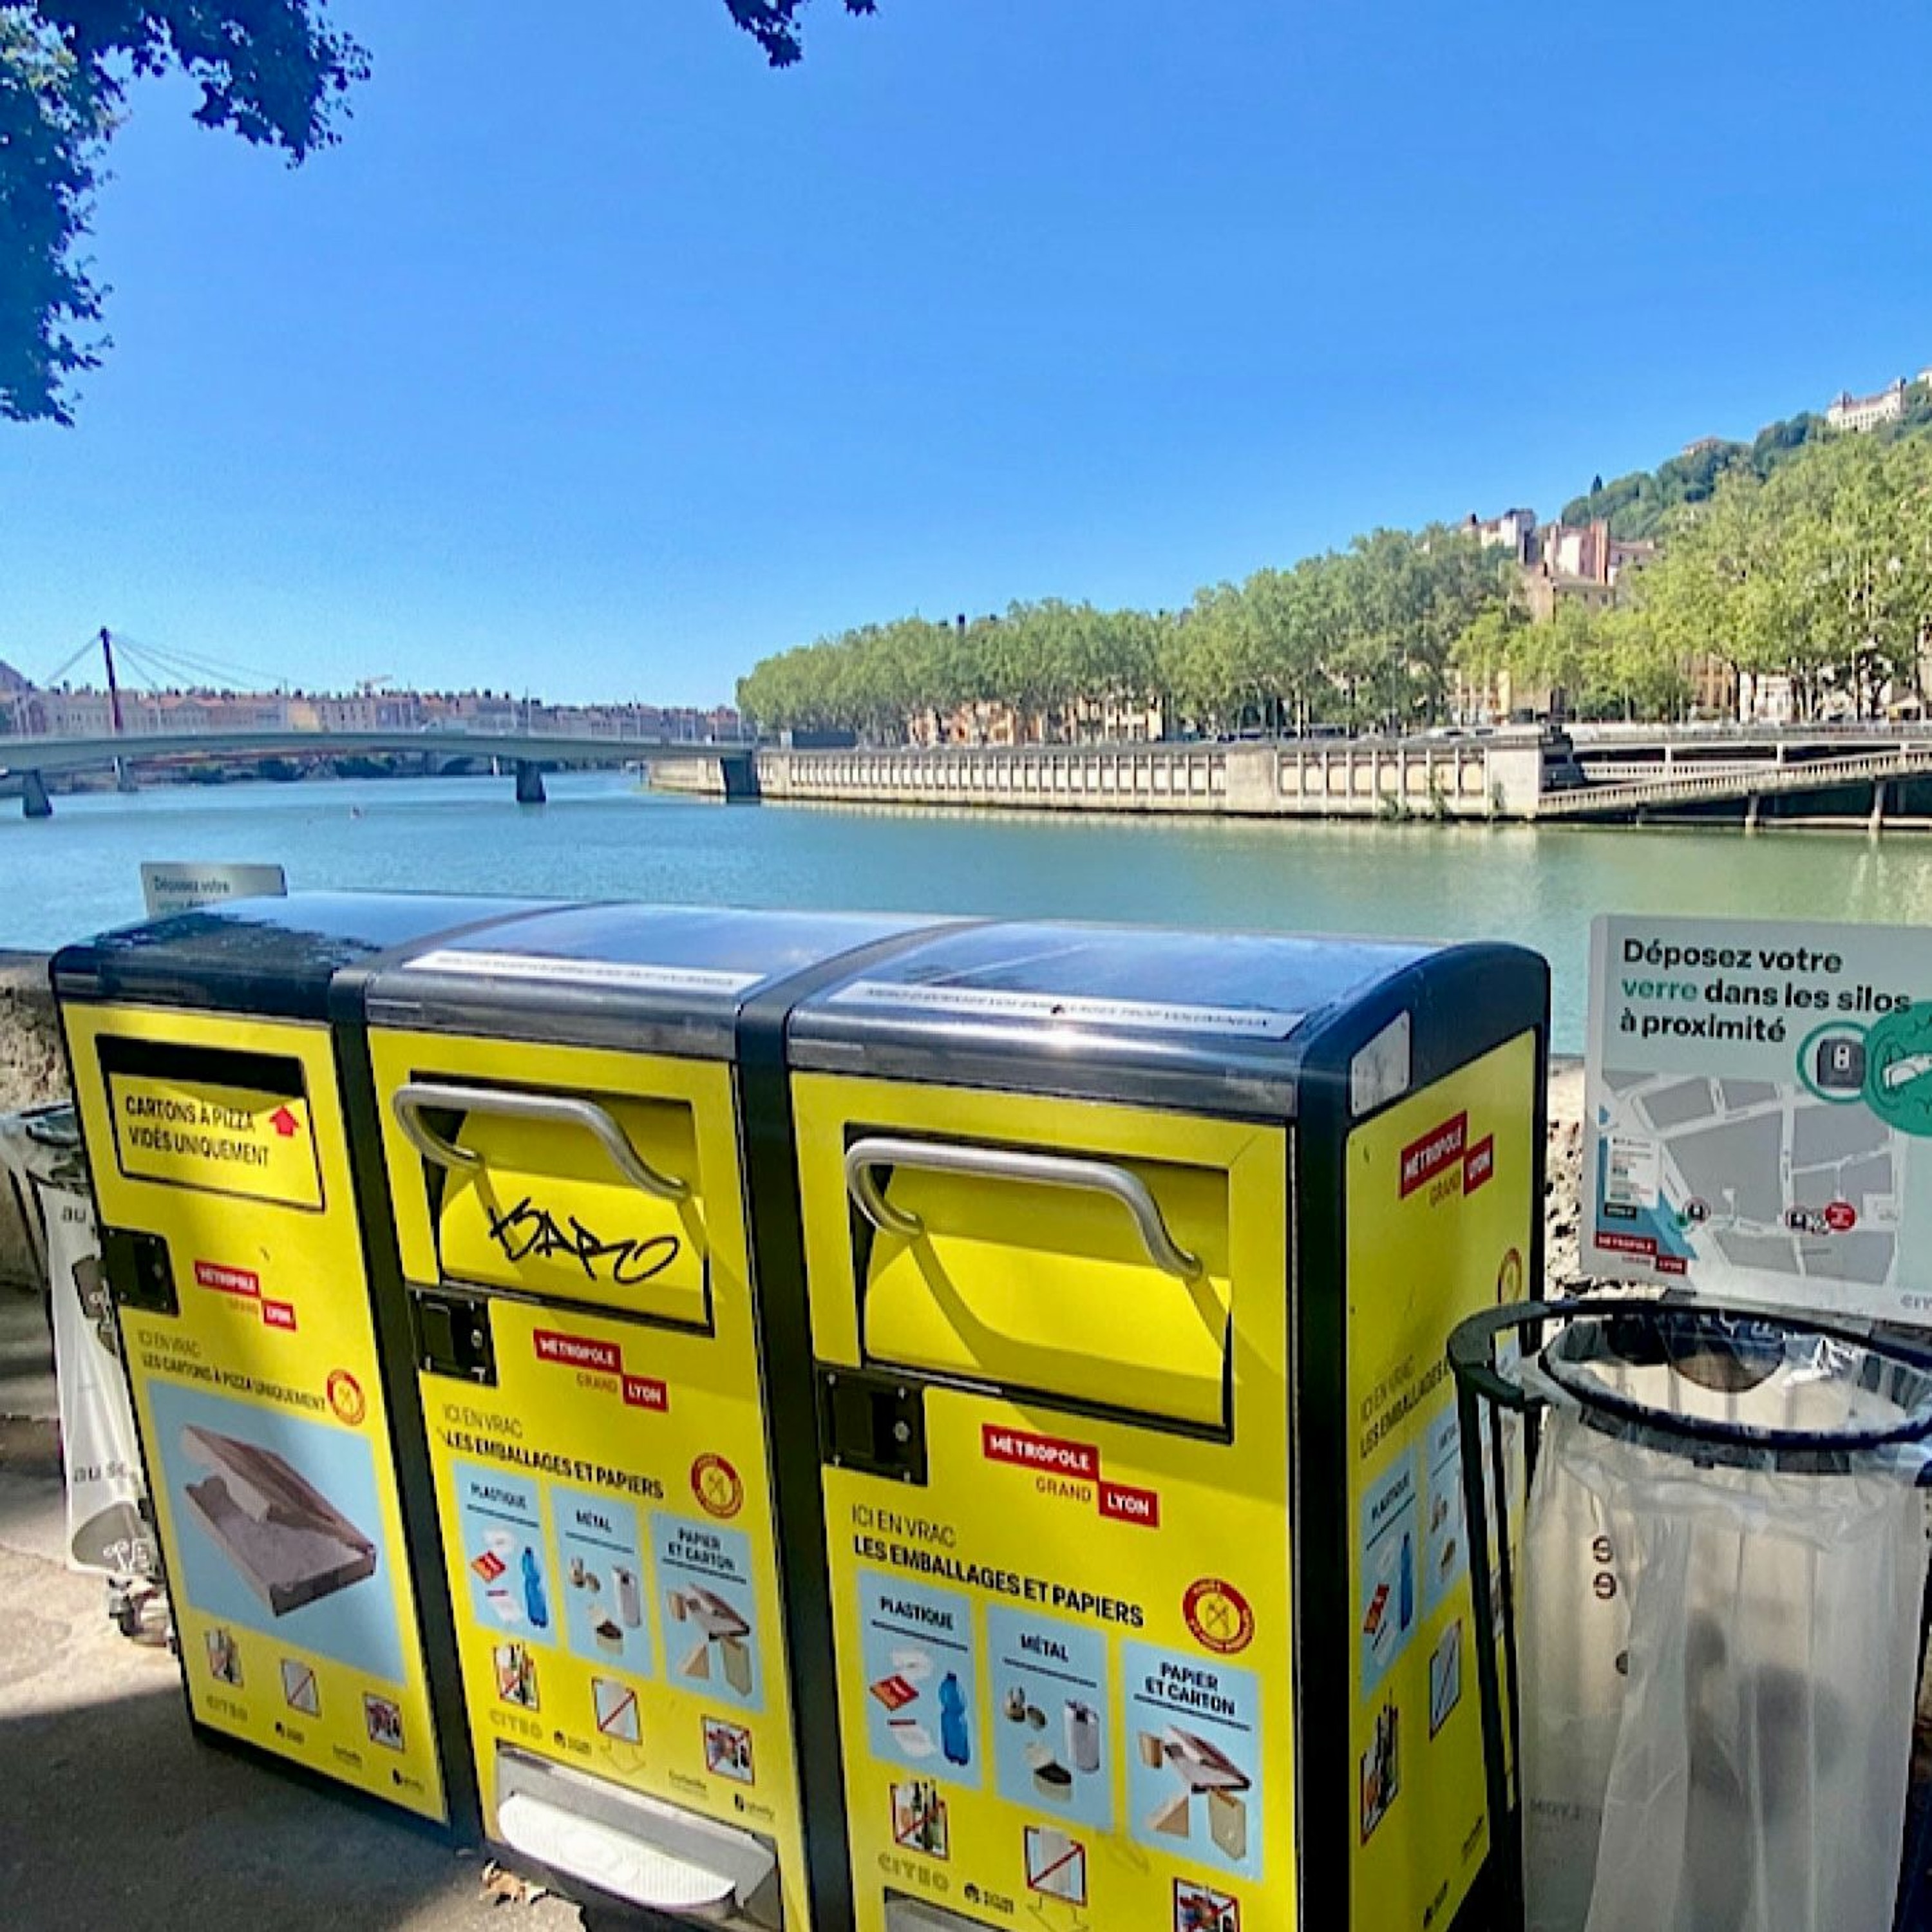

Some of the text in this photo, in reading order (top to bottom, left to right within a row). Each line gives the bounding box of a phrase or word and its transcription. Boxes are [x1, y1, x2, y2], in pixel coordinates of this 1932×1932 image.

[1624, 938, 1842, 973] Déposez votre
[1621, 978, 1913, 1014] verre dans les silos
[1620, 1007, 1786, 1043] à proximité
[126, 1095, 196, 1125] CARTONS
[213, 1106, 256, 1132] PIZZA
[174, 1132, 269, 1167] UNIQUEMENT
[628, 1382, 662, 1405] LYON
[447, 1429, 474, 1453] LES
[475, 1437, 572, 1477] EMBALLAGES
[574, 1459, 593, 1482] ET
[596, 1465, 664, 1499] PAPIERS
[1036, 1476, 1150, 1517] GRAND LYON
[678, 1526, 721, 1551] PAPIER
[852, 1504, 956, 1547] ICI EN VRAC
[668, 1541, 736, 1571] ET CARTON
[853, 1535, 887, 1562] LES
[889, 1544, 1020, 1597] EMBALLAGES
[1024, 1578, 1048, 1604] ET
[1051, 1584, 1144, 1628] PAPIERS
[880, 1595, 954, 1631] PLASTIQUE
[1020, 1632, 1070, 1663] MÉTAL
[1160, 1661, 1219, 1693] PAPIER
[1145, 1675, 1236, 1716] ET CARTON
